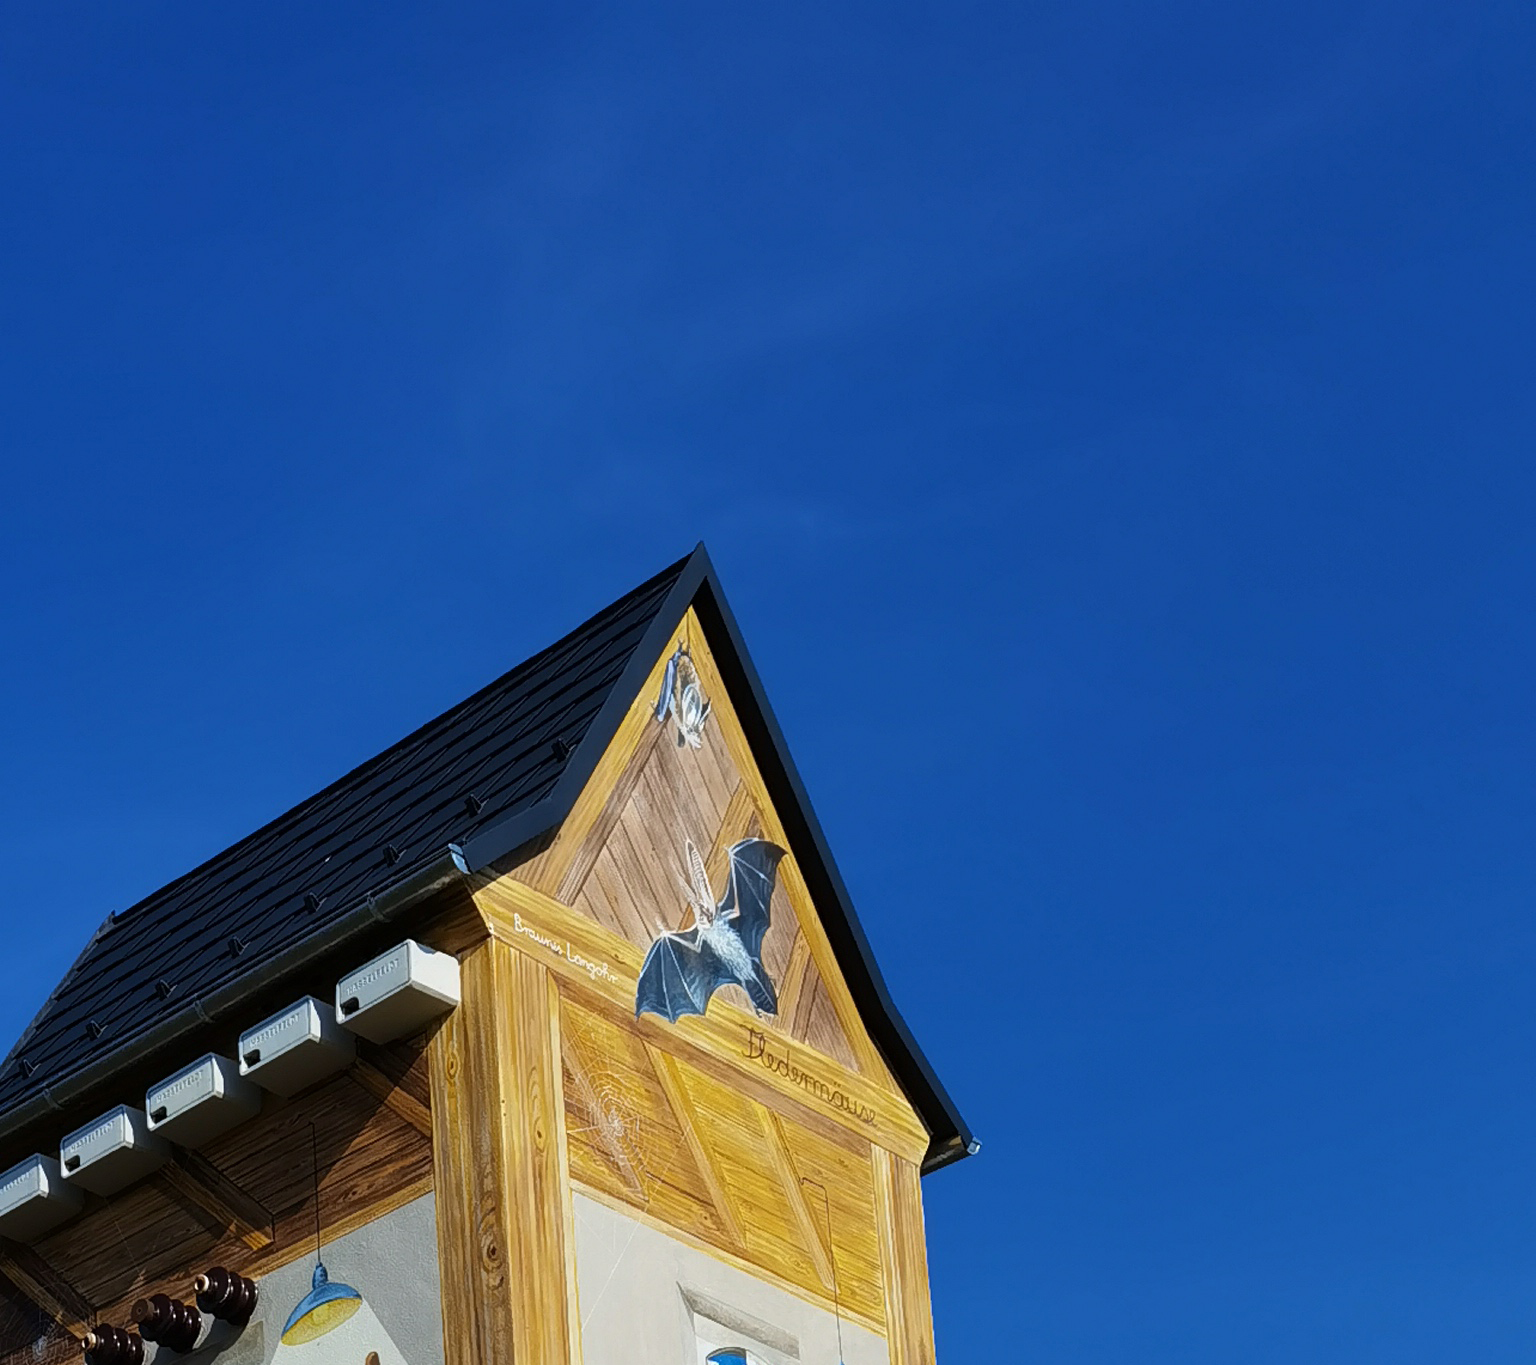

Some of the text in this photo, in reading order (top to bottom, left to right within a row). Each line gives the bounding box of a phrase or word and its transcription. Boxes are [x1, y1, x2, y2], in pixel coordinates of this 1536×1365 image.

[513, 912, 618, 982] Braunes Langohr
[739, 1023, 878, 1128] Fledermäuse
